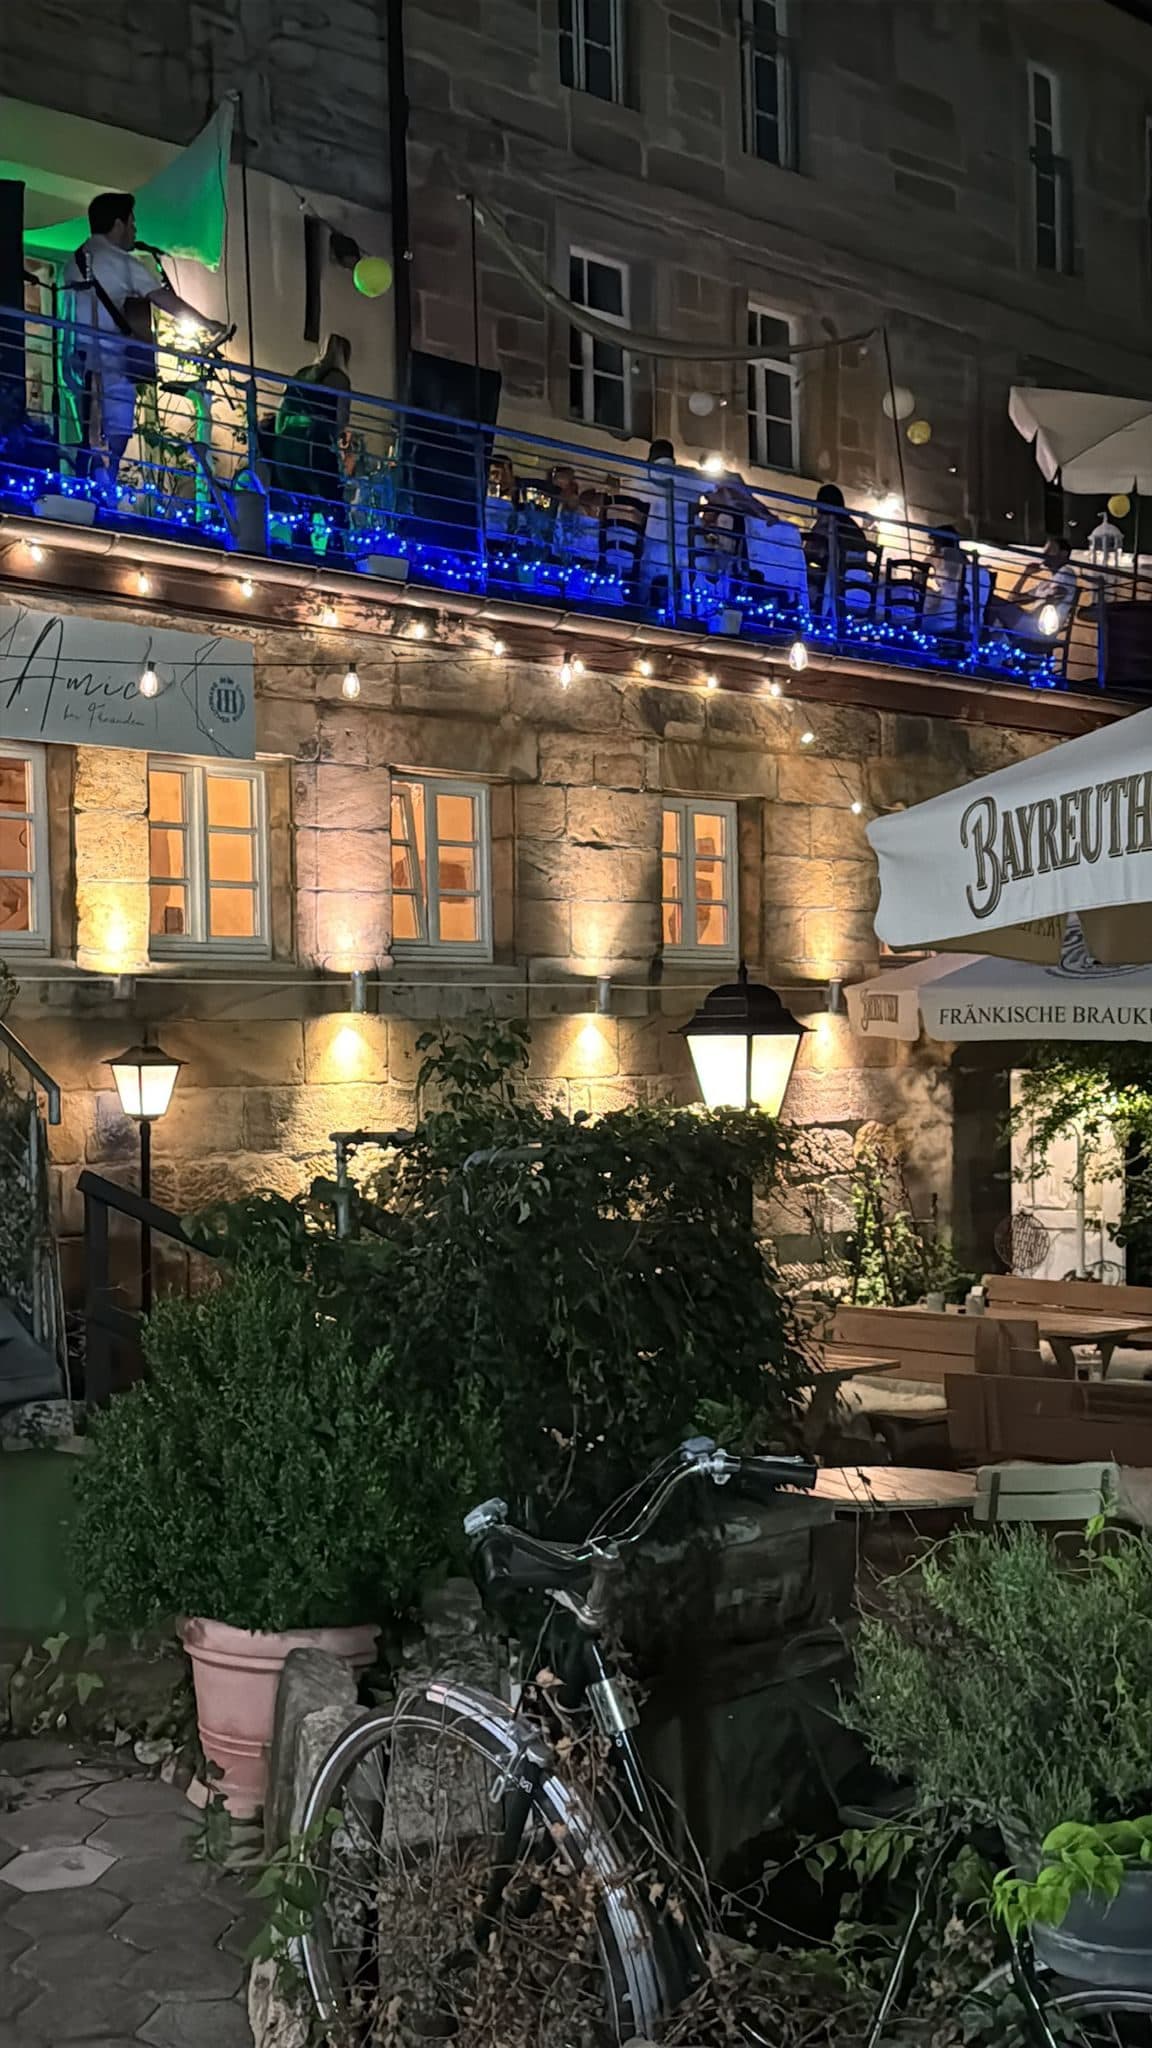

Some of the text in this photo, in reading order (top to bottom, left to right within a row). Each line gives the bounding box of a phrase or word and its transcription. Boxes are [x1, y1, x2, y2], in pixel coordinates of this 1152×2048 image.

[0, 616, 173, 732] Amic
[959, 770, 1152, 919] BAYREUTH
[939, 1004, 1152, 1025] FRÄNKISCHE BRAUK
